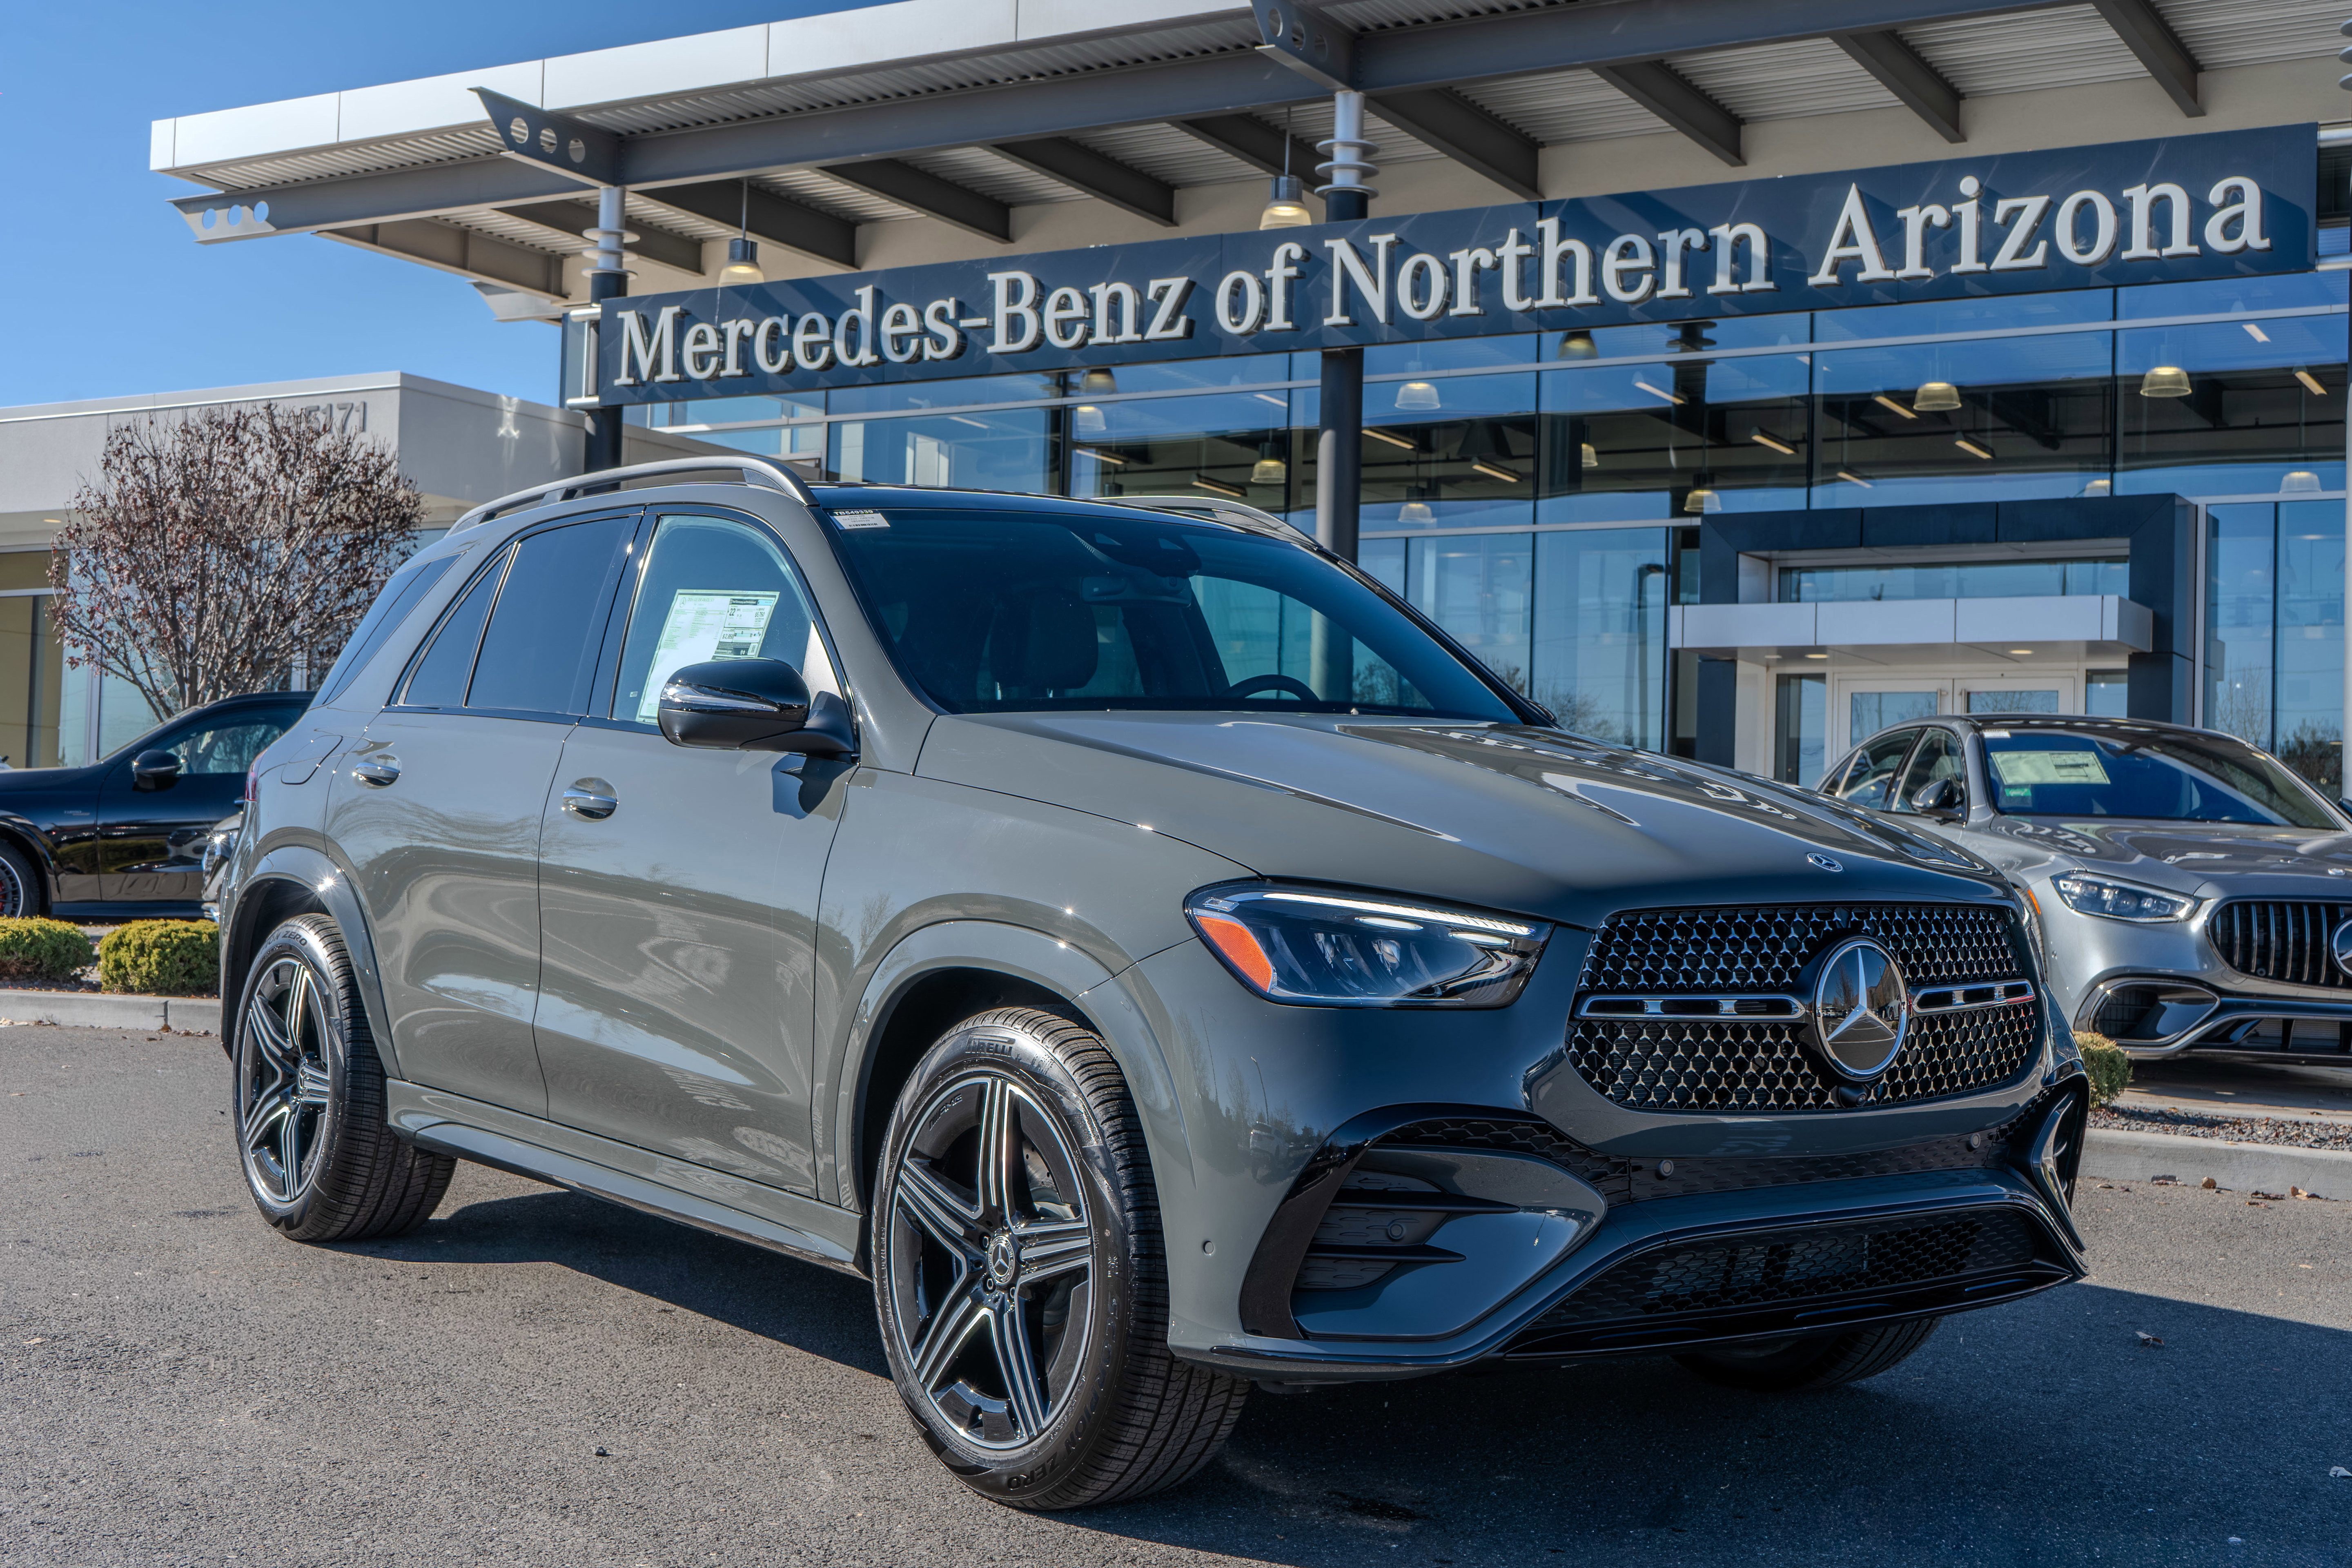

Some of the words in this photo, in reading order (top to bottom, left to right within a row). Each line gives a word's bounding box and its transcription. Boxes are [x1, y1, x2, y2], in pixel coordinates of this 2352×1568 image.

[614, 270, 1189, 386] Mercedes-Benz
[1215, 242, 1303, 334] of
[1323, 217, 1775, 326] Northern
[1807, 175, 2271, 285] Arizona
[729, 608, 736, 616] 22
[282, 931, 308, 947] ZERO
[965, 1034, 1016, 1058] PIRELLI
[1007, 1451, 1060, 1490] ZERO
